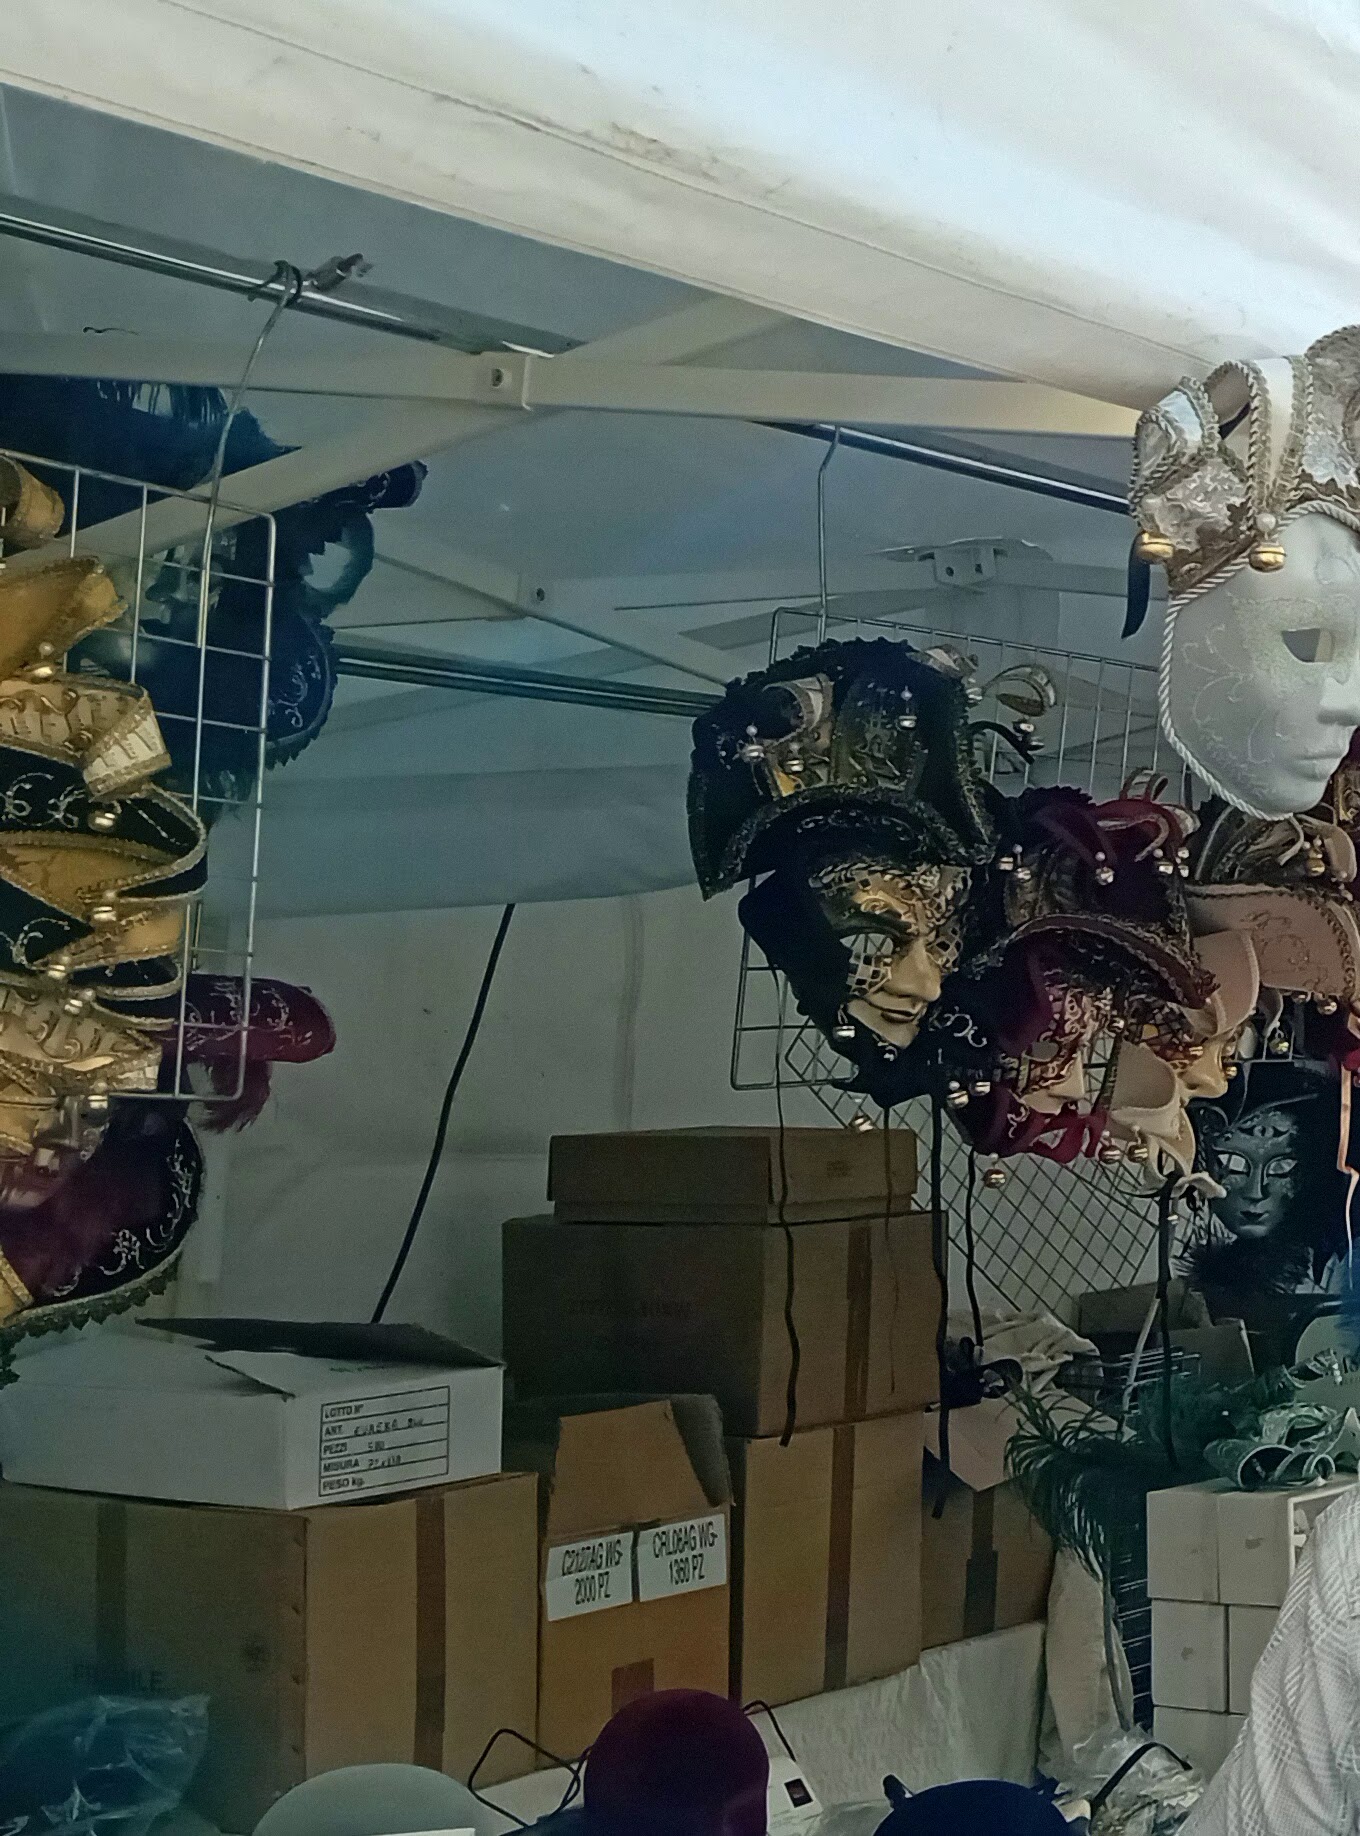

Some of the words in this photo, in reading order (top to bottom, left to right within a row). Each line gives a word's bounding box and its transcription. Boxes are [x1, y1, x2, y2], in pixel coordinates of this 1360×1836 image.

[325, 1405, 352, 1419] LOTTO
[323, 1442, 348, 1455] PEZZI
[323, 1458, 360, 1473] MISURA
[322, 1478, 350, 1491] PESO
[692, 1552, 706, 1581] PZ
[574, 1574, 597, 1605] 2000
[598, 1570, 611, 1600] PZ
